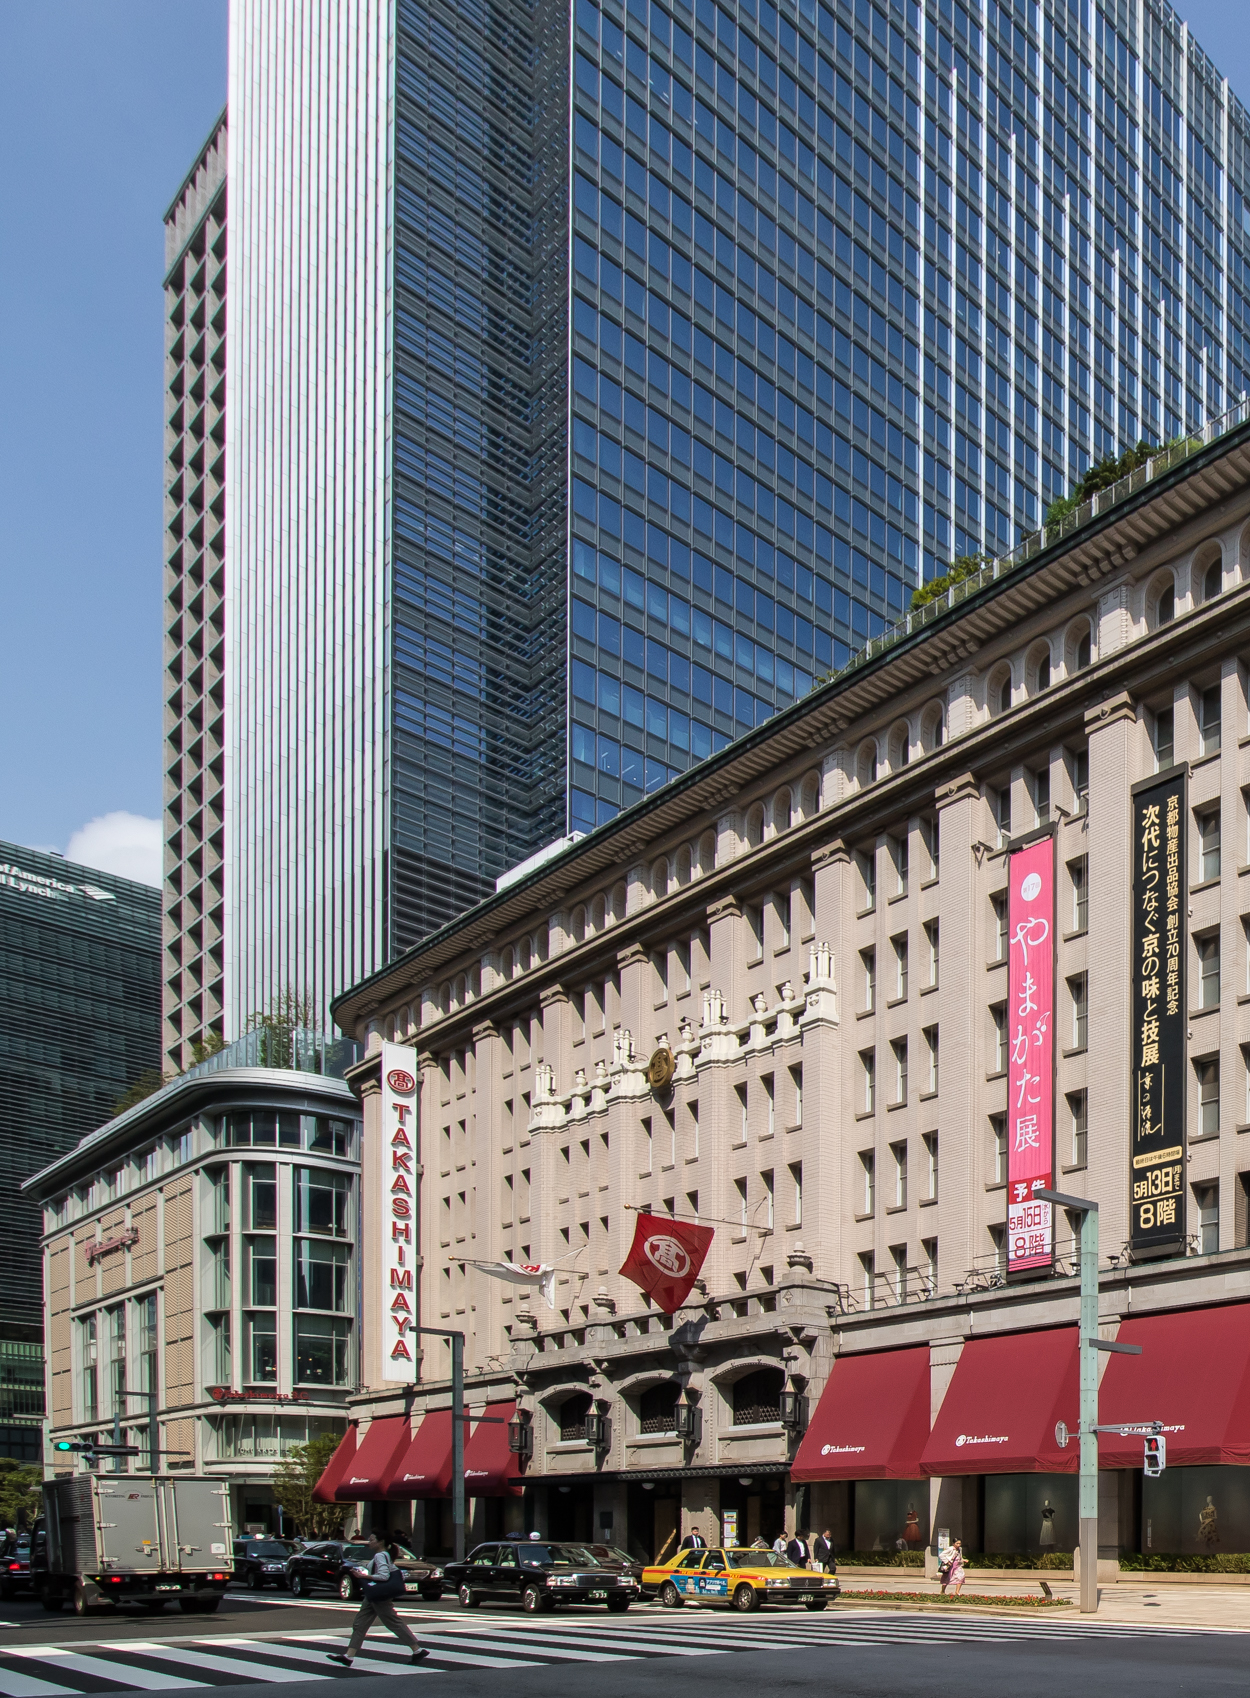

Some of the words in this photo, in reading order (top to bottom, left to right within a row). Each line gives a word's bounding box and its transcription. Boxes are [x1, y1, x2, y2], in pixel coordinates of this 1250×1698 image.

[1166, 794, 1179, 912] 京都物産出品協会
[8, 876, 58, 899] Lynch
[10, 866, 75, 893] America
[1141, 804, 1160, 1068] 次代につなぐ京の味と技展
[1166, 912, 1179, 1016] 創立70周年記念
[1010, 916, 1050, 1152] やまがた展
[1134, 1167, 1173, 1198] 5月13日
[1009, 1205, 1042, 1231] 5月15日
[1140, 1199, 1176, 1229] 8階
[391, 1103, 412, 1360] TAKASHIMAYA
[1014, 1233, 1045, 1258] 8階
[966, 1434, 1009, 1444] Takashimaya
